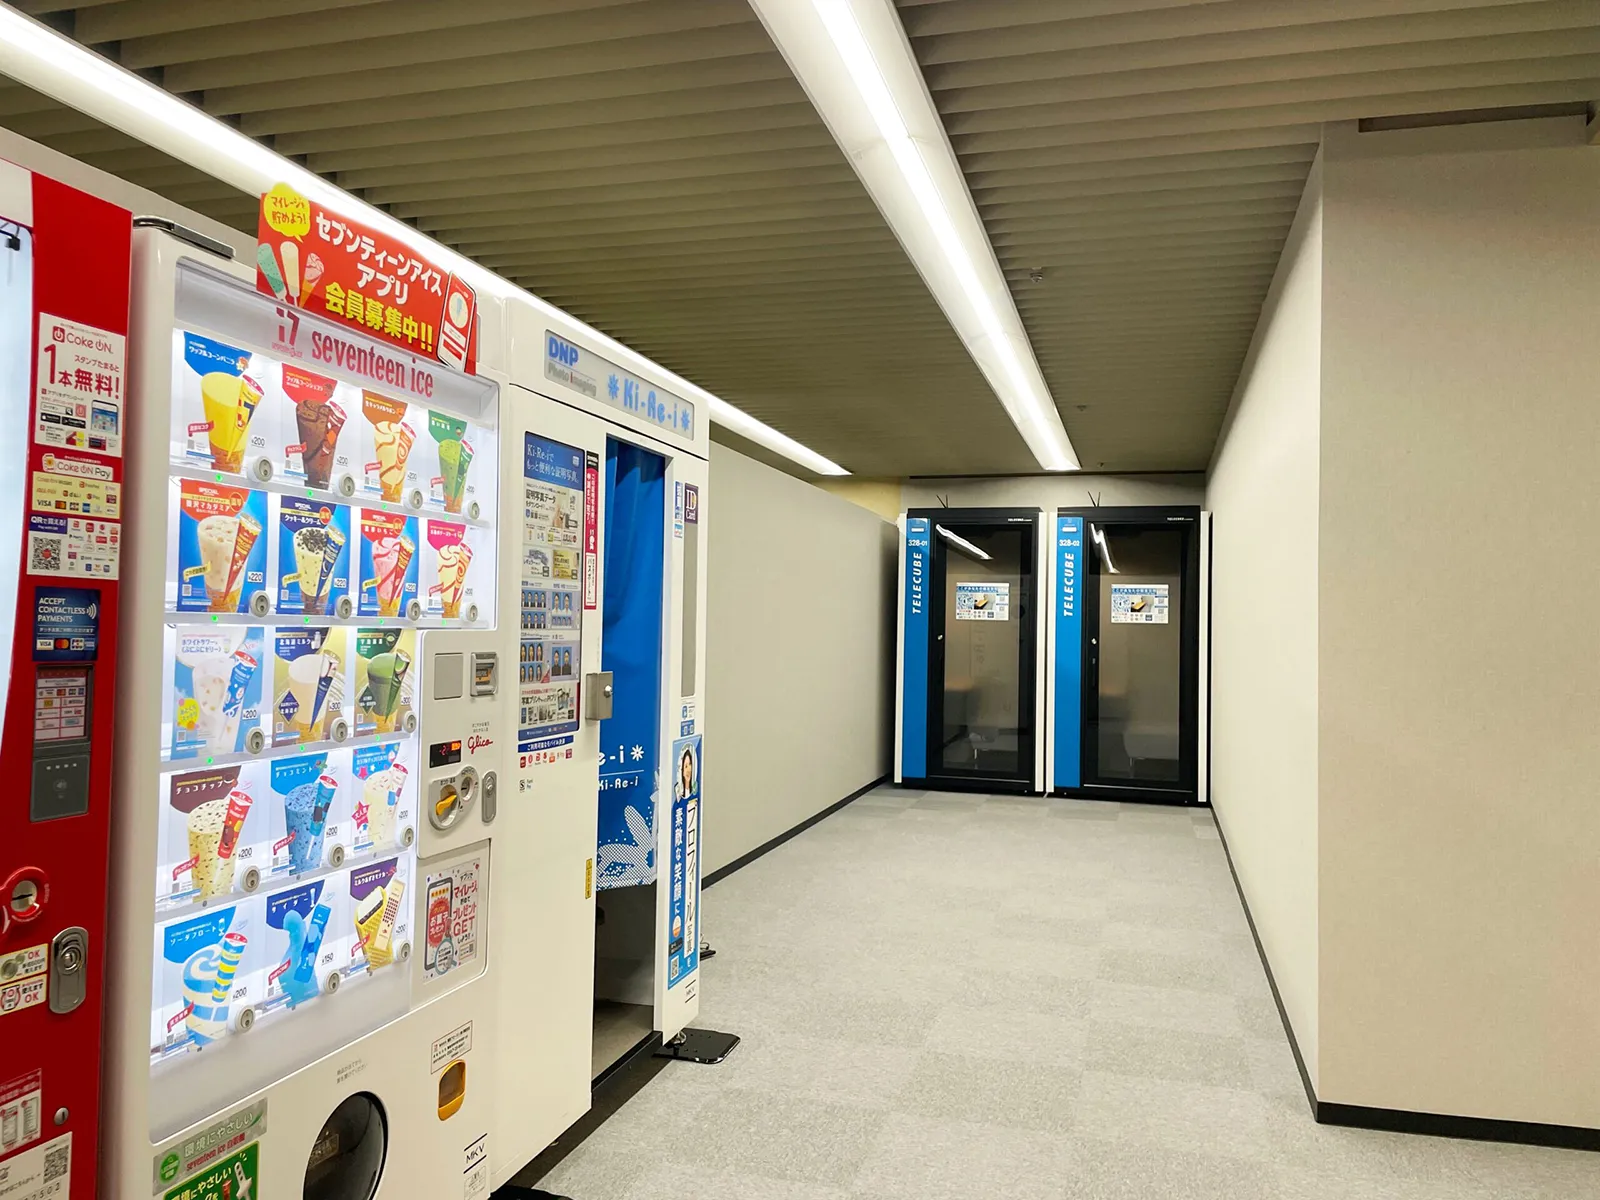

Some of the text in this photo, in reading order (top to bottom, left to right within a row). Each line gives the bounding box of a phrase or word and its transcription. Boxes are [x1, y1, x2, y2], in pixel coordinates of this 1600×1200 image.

[271, 209, 307, 226] 貯めよう!
[315, 211, 443, 297] セブンティーンアイス
[356, 262, 409, 305] アプリ
[325, 281, 433, 353] 会員募集中!!
[66, 332, 94, 349] Coke
[548, 335, 579, 367] DNP
[74, 354, 120, 373] スタンプたまると
[311, 329, 434, 399] seventeen ice
[547, 362, 597, 397] Photo Imaging
[57, 461, 79, 473] Coke
[94, 467, 112, 480] Pay
[37, 499, 52, 507] VISA
[908, 538, 928, 548] 328-01
[1058, 538, 1080, 548] 328-02
[912, 552, 922, 614] TELECUBE
[1063, 552, 1075, 618] TELECUBE
[38, 597, 66, 605] ACCEPT
[38, 606, 86, 615] CONTACTLESS
[37, 614, 73, 623] PAYMENTS
[39, 640, 52, 648] VISA
[279, 637, 312, 646] 北海道ミルク
[467, 734, 494, 755] Glico
[175, 780, 223, 795] チョコチップ
[238, 847, 253, 858] ¥200
[453, 901, 477, 922] プレゼント
[170, 925, 217, 946] ソーダフロート
[453, 915, 476, 937] GET
[27, 949, 41, 960] OK
[24, 991, 39, 1004] OK
[232, 985, 248, 1000] ¥200
[183, 1112, 254, 1159] 環境にやさしい
[186, 1149, 217, 1172] seventeen
[216, 1143, 227, 1156] ice
[465, 1142, 485, 1165] MKV
